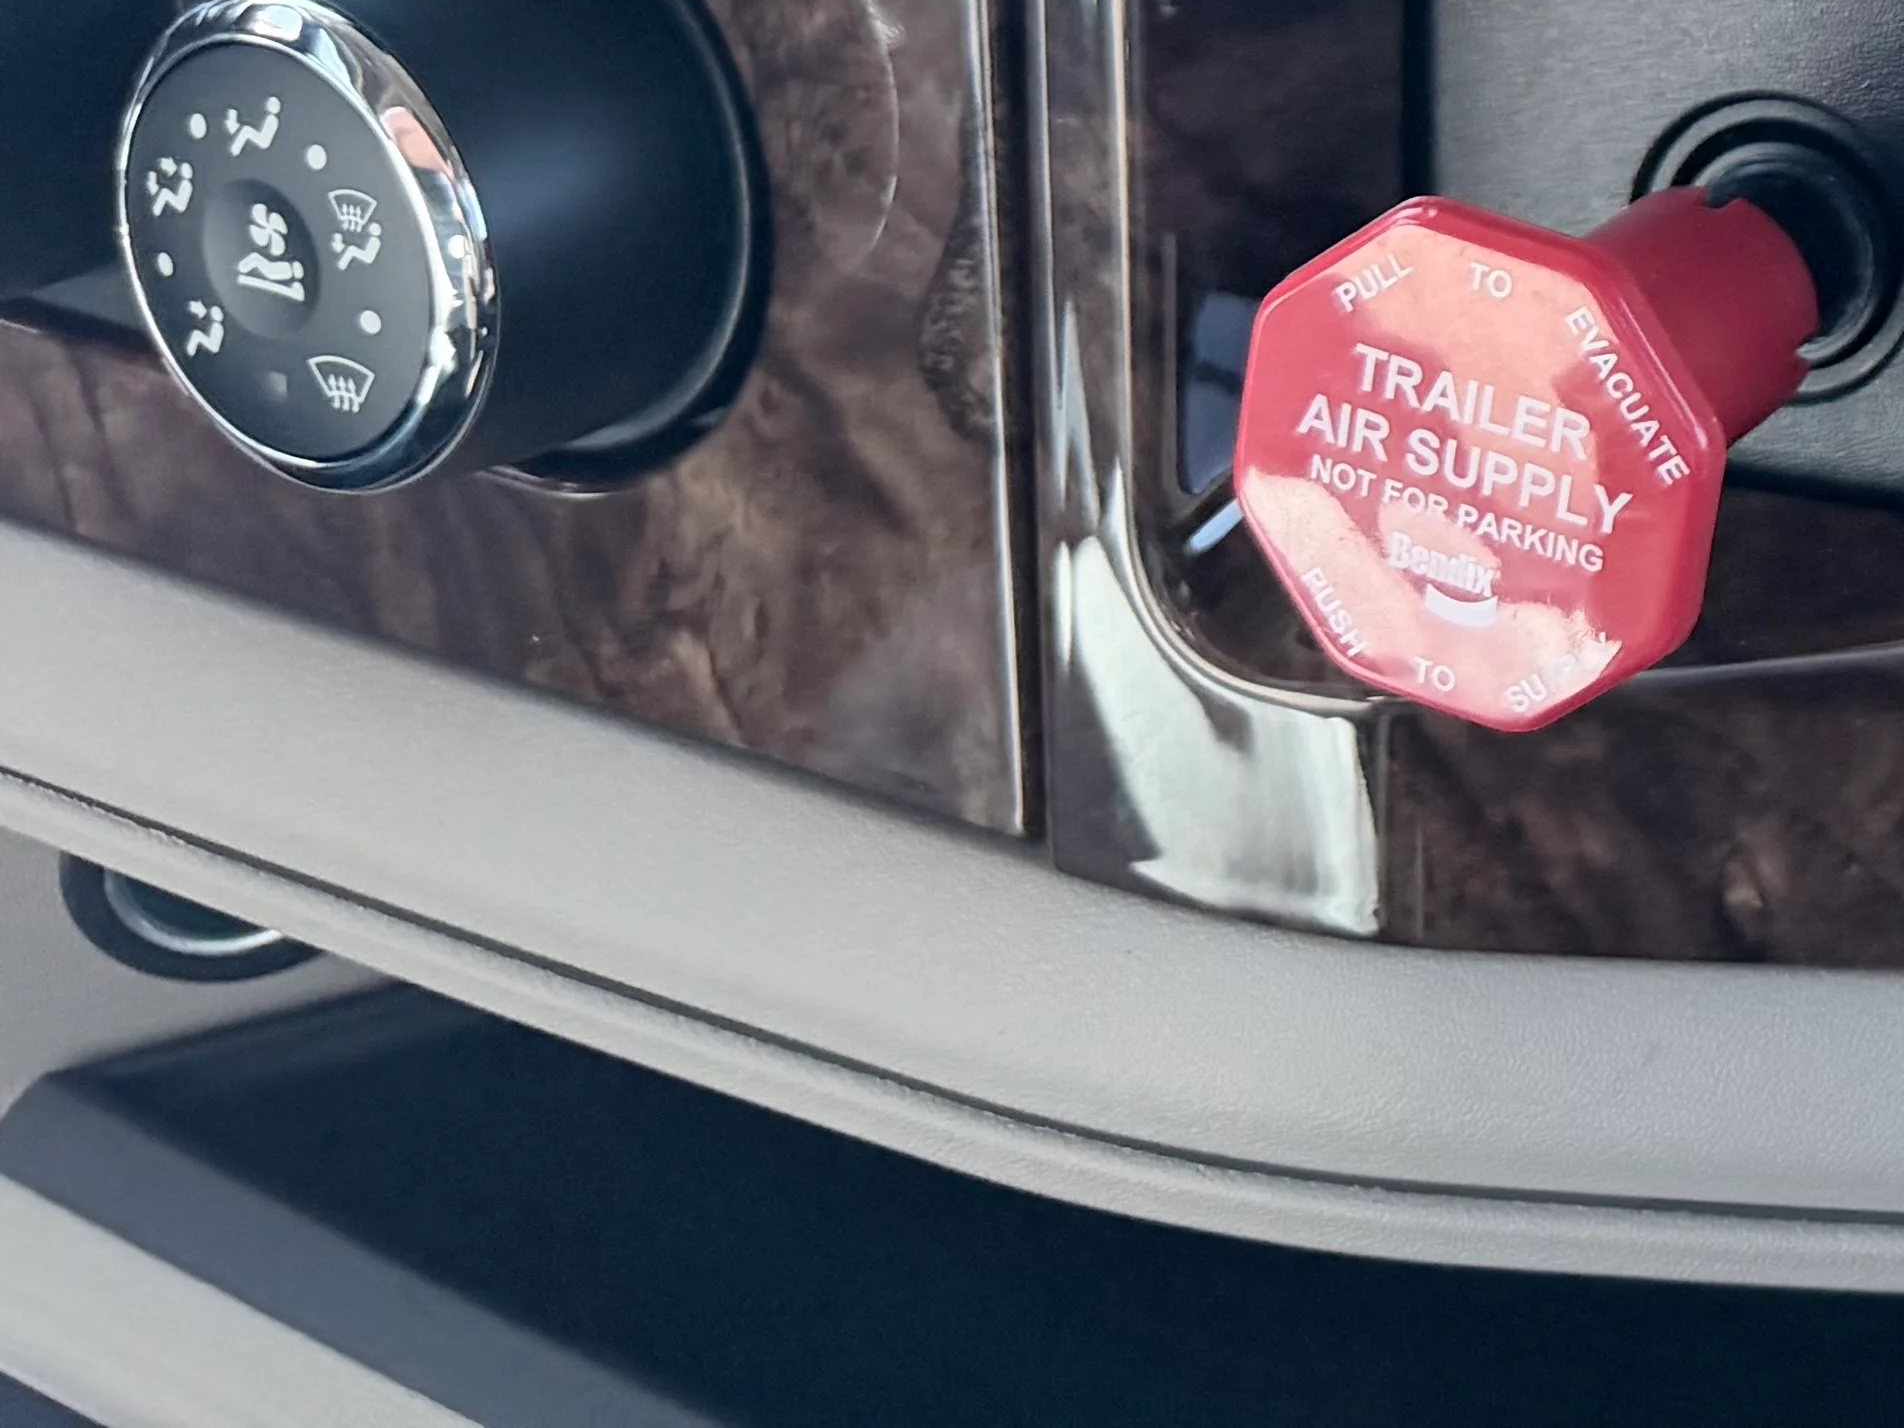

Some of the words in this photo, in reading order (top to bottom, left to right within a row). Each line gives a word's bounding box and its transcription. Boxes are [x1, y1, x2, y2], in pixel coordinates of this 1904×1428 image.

[1333, 253, 1413, 312] PULL
[1467, 262, 1513, 300] TO
[1564, 304, 1691, 487] EVACUATE
[1355, 343, 1594, 461] TRAILER
[1298, 393, 1392, 463] AIR
[1405, 427, 1635, 535] SUPPLY
[1311, 454, 1377, 497] NOT
[1382, 478, 1449, 519] FOR
[1456, 503, 1604, 573] PARKING
[1386, 529, 1496, 596] Bendix
[1301, 566, 1366, 658] PUSH
[1413, 655, 1457, 692] TO
